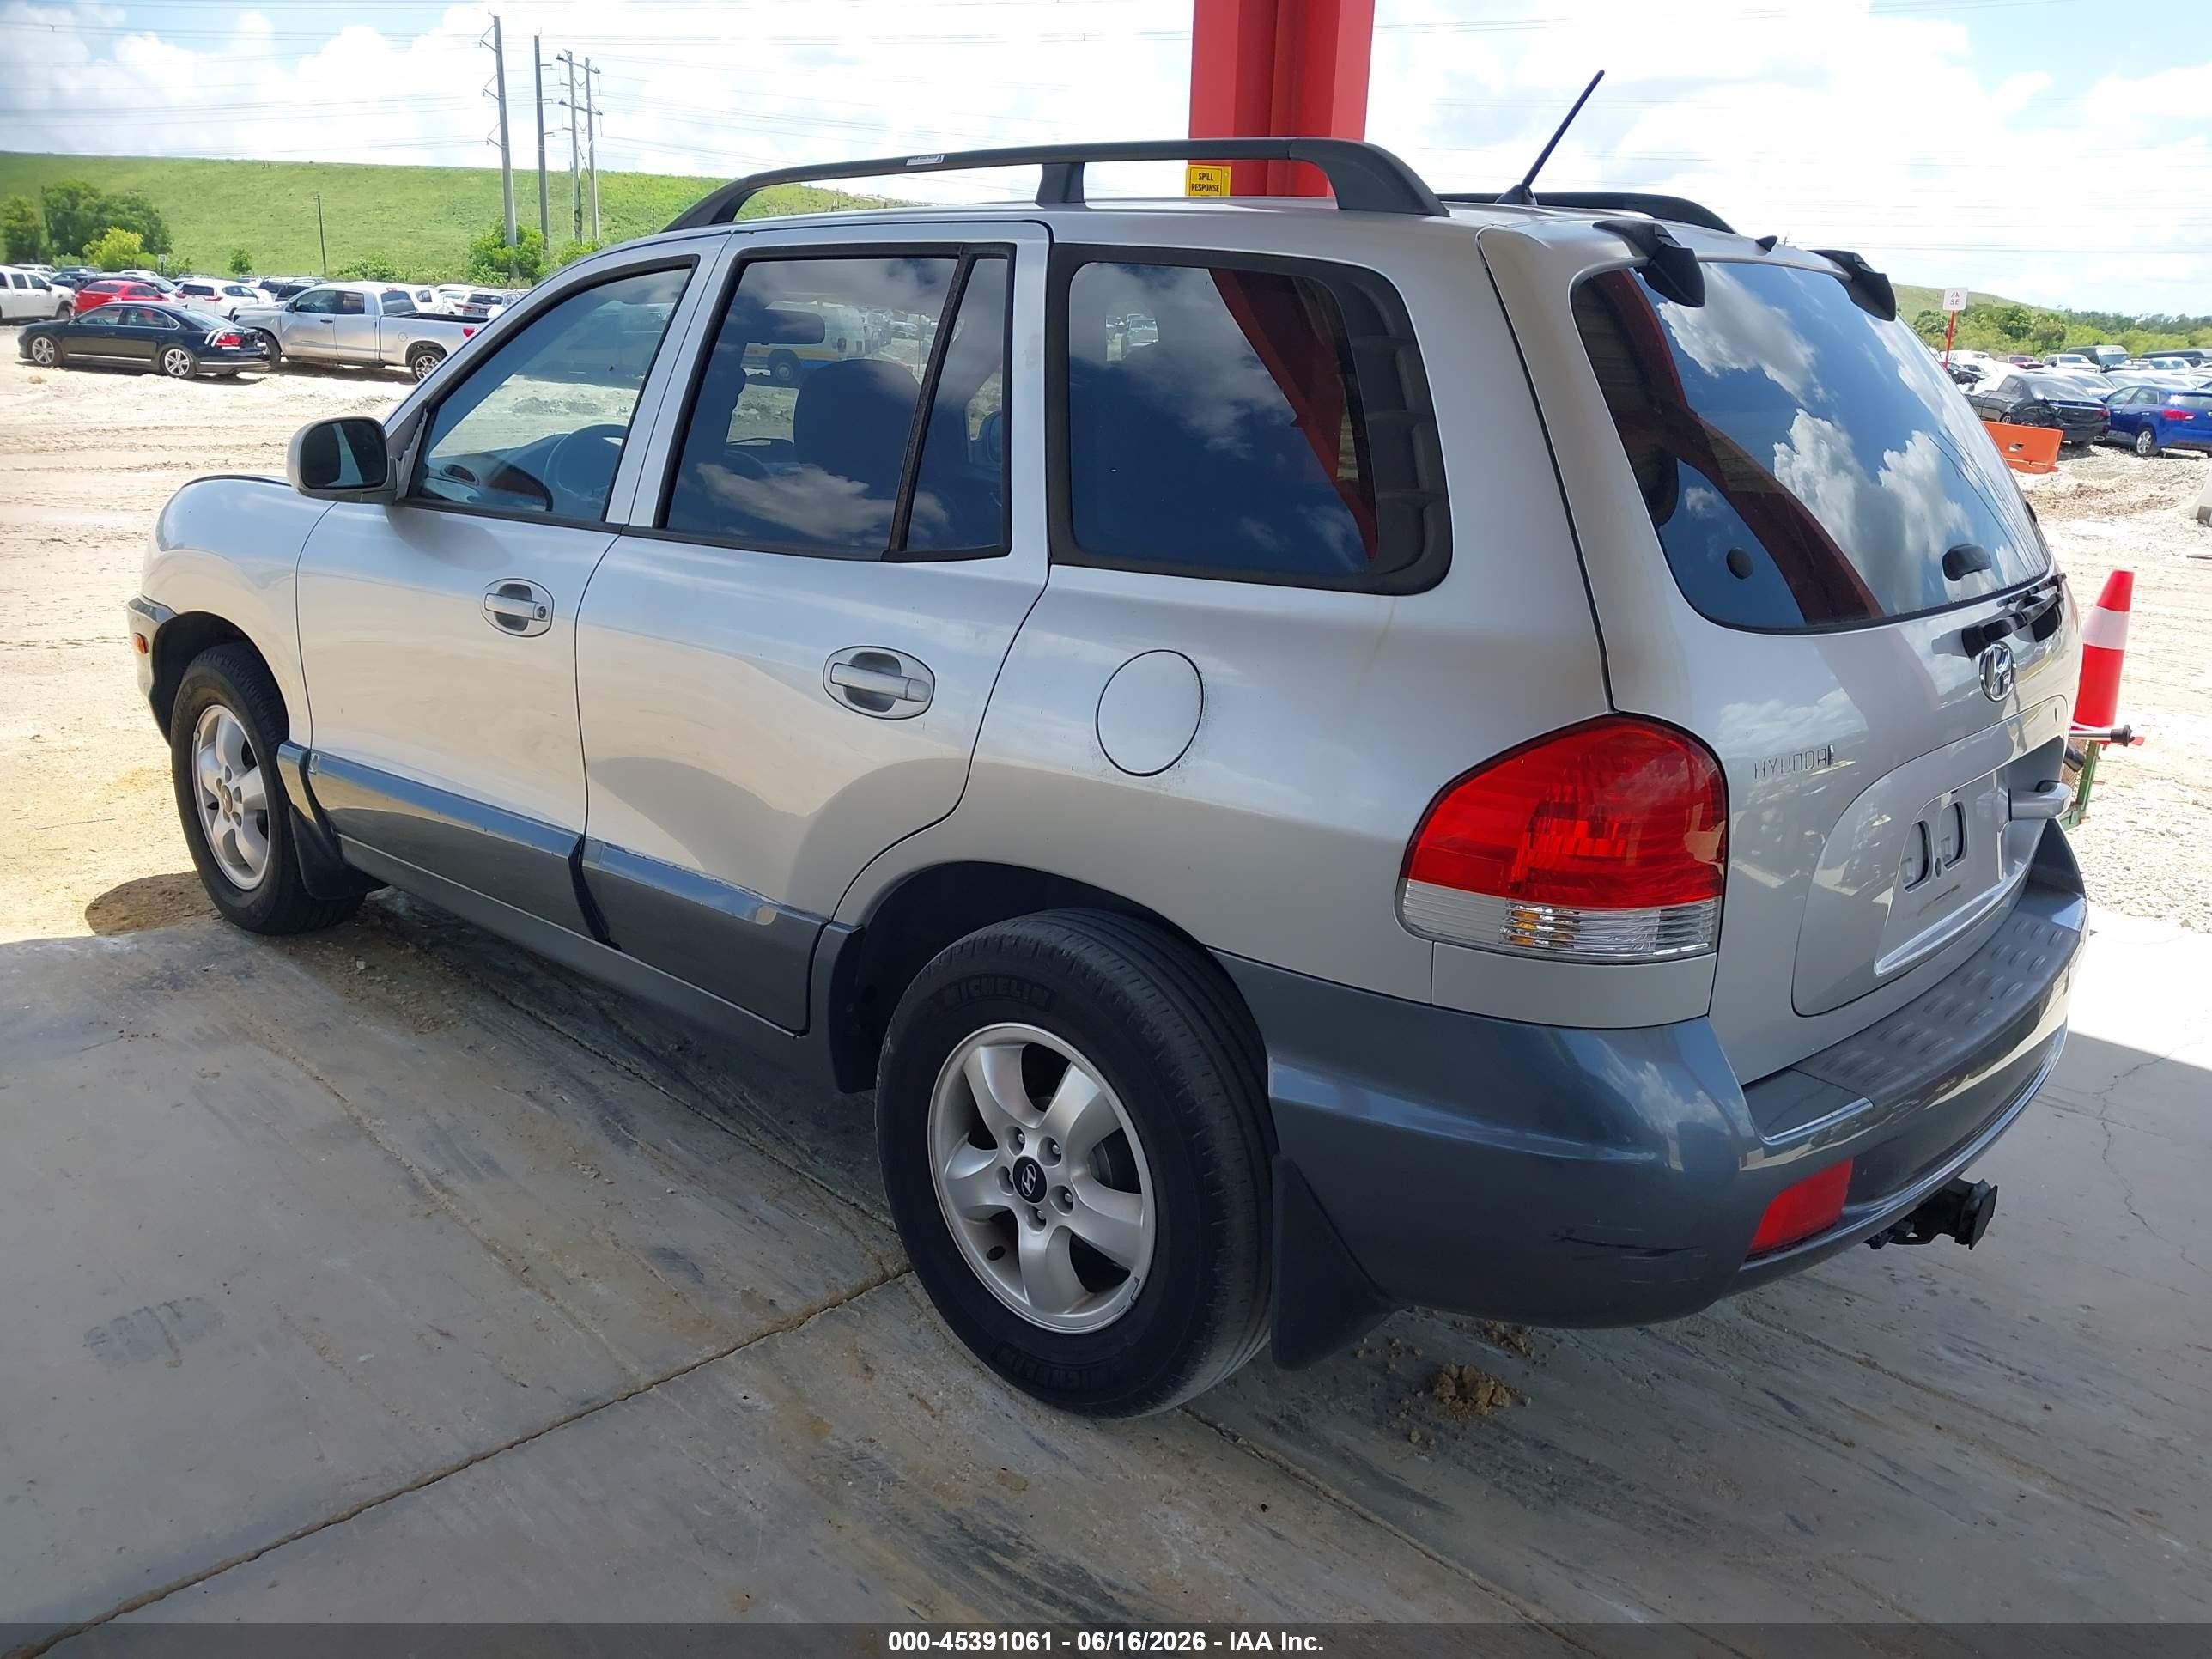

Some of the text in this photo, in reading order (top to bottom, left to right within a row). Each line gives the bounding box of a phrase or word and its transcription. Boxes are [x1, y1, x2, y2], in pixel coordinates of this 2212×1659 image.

[1198, 172, 1214, 181] SPILL
[1191, 183, 1220, 193] RESPONSE
[1753, 744, 1834, 779] HYUNDAI
[943, 975, 1049, 1010] MICHELIN
